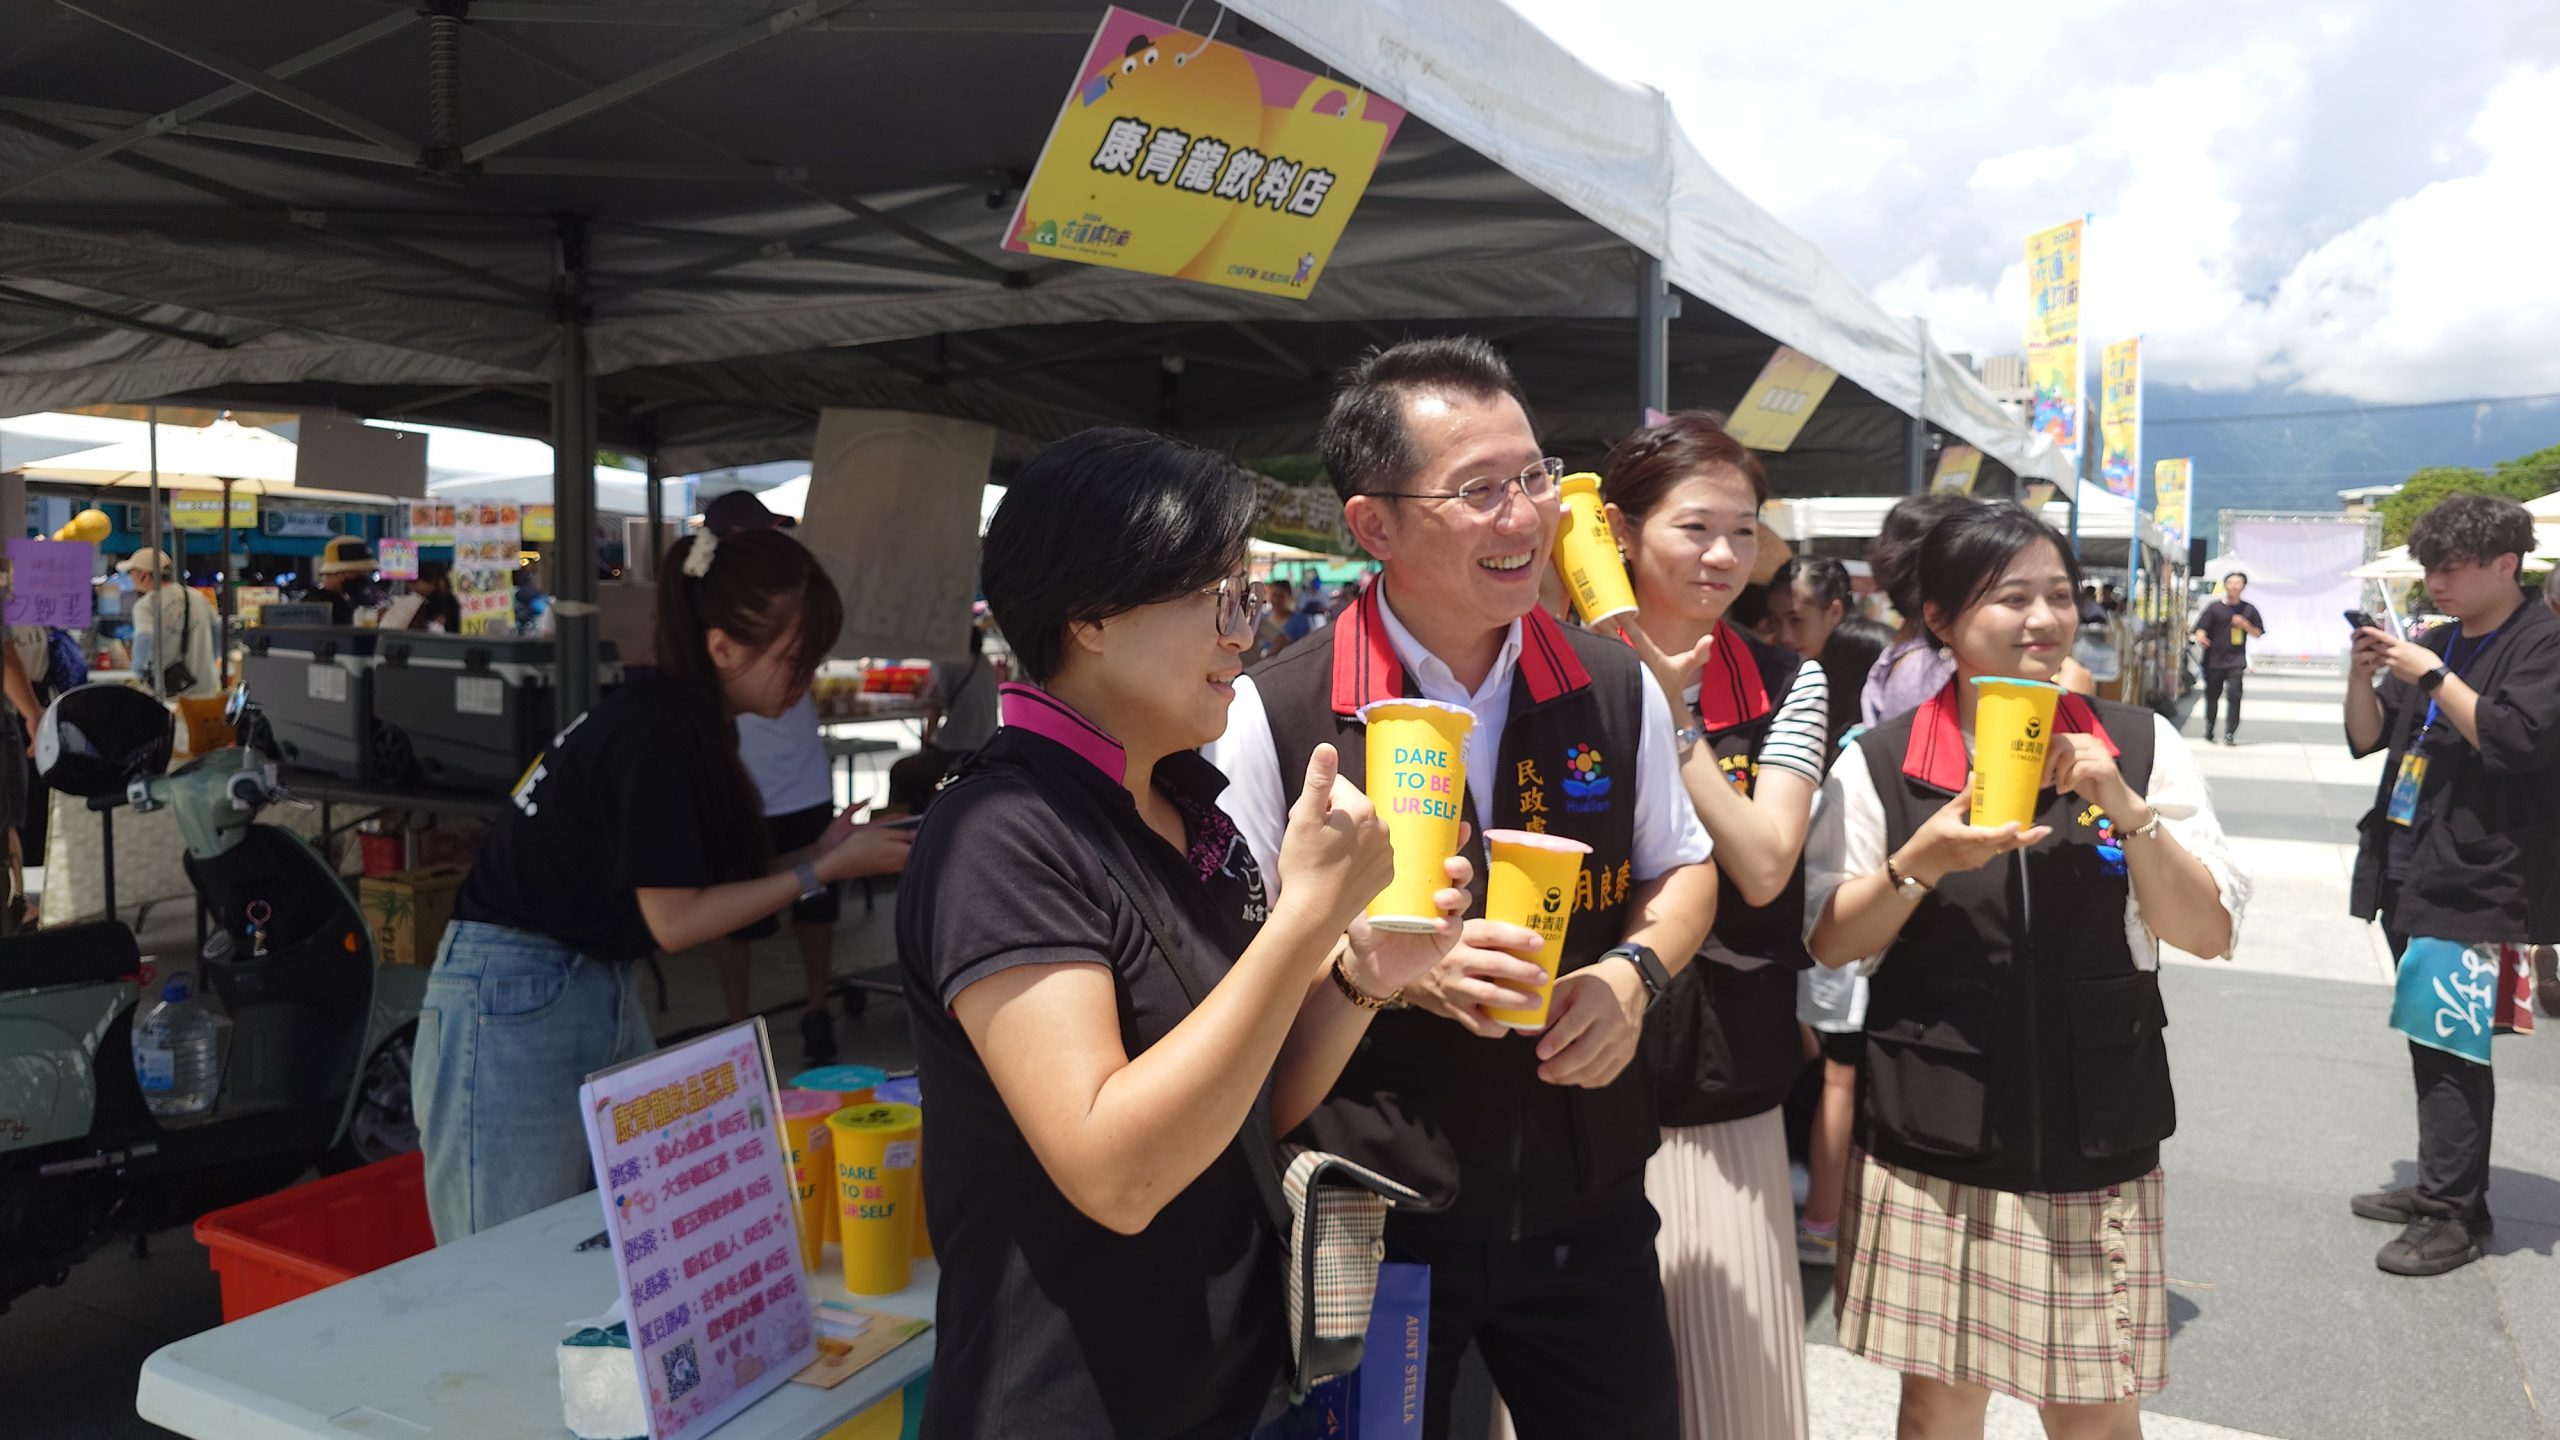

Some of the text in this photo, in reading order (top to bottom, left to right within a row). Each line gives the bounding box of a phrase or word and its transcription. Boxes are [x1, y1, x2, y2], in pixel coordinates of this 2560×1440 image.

[1092, 117, 1336, 217] 康青龍飲料店
[1394, 747, 1448, 769] DARE
[1394, 771, 1452, 795] TO BE
[1393, 797, 1457, 820] URSELF
[839, 1163, 878, 1180] DARE
[841, 1182, 884, 1199] TO BE
[844, 1204, 896, 1219] URSELF
[1403, 1314, 1419, 1424] AUNT STELLA
